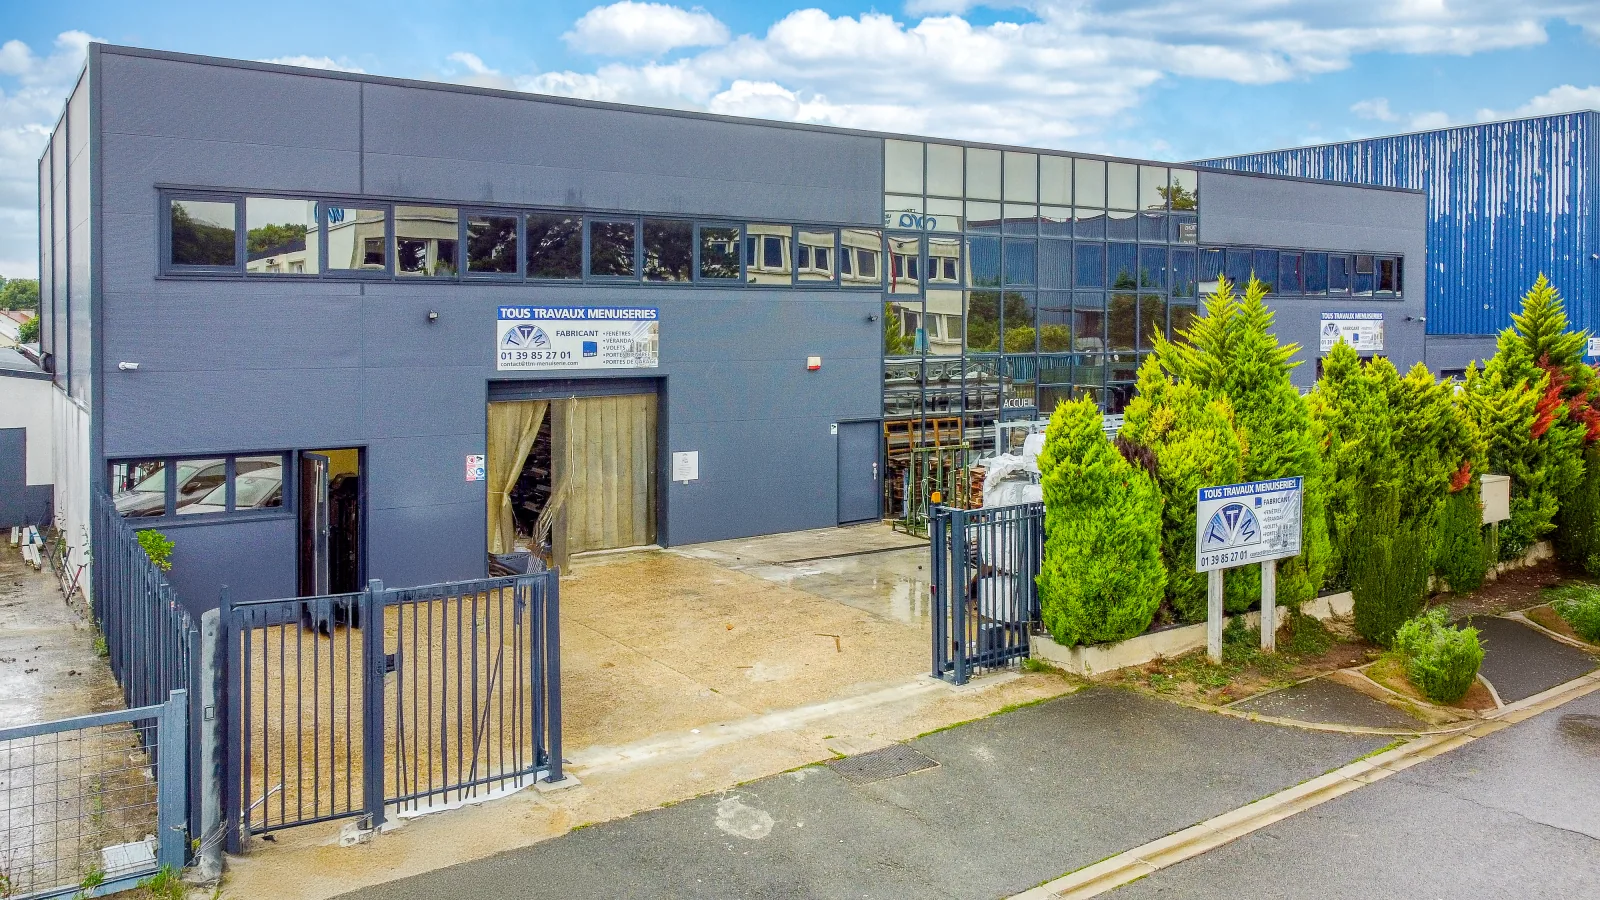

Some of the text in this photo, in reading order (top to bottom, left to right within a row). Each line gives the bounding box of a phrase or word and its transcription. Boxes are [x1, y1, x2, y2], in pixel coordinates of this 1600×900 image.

[500, 308, 657, 319] TOUS TRAVAUX MENUISERIES
[501, 352, 512, 360] 01
[516, 352, 527, 360] 39
[531, 352, 543, 360] 85
[560, 351, 571, 359] 01
[1204, 490, 1222, 498] TOUS
[1224, 485, 1254, 496] TRAVAUX
[1263, 496, 1290, 505] FABRICANT
[1201, 557, 1209, 567] 01
[1211, 555, 1219, 565] 39
[1221, 553, 1229, 564] 85
[1231, 552, 1238, 562] 27
[1240, 550, 1248, 560] 01
